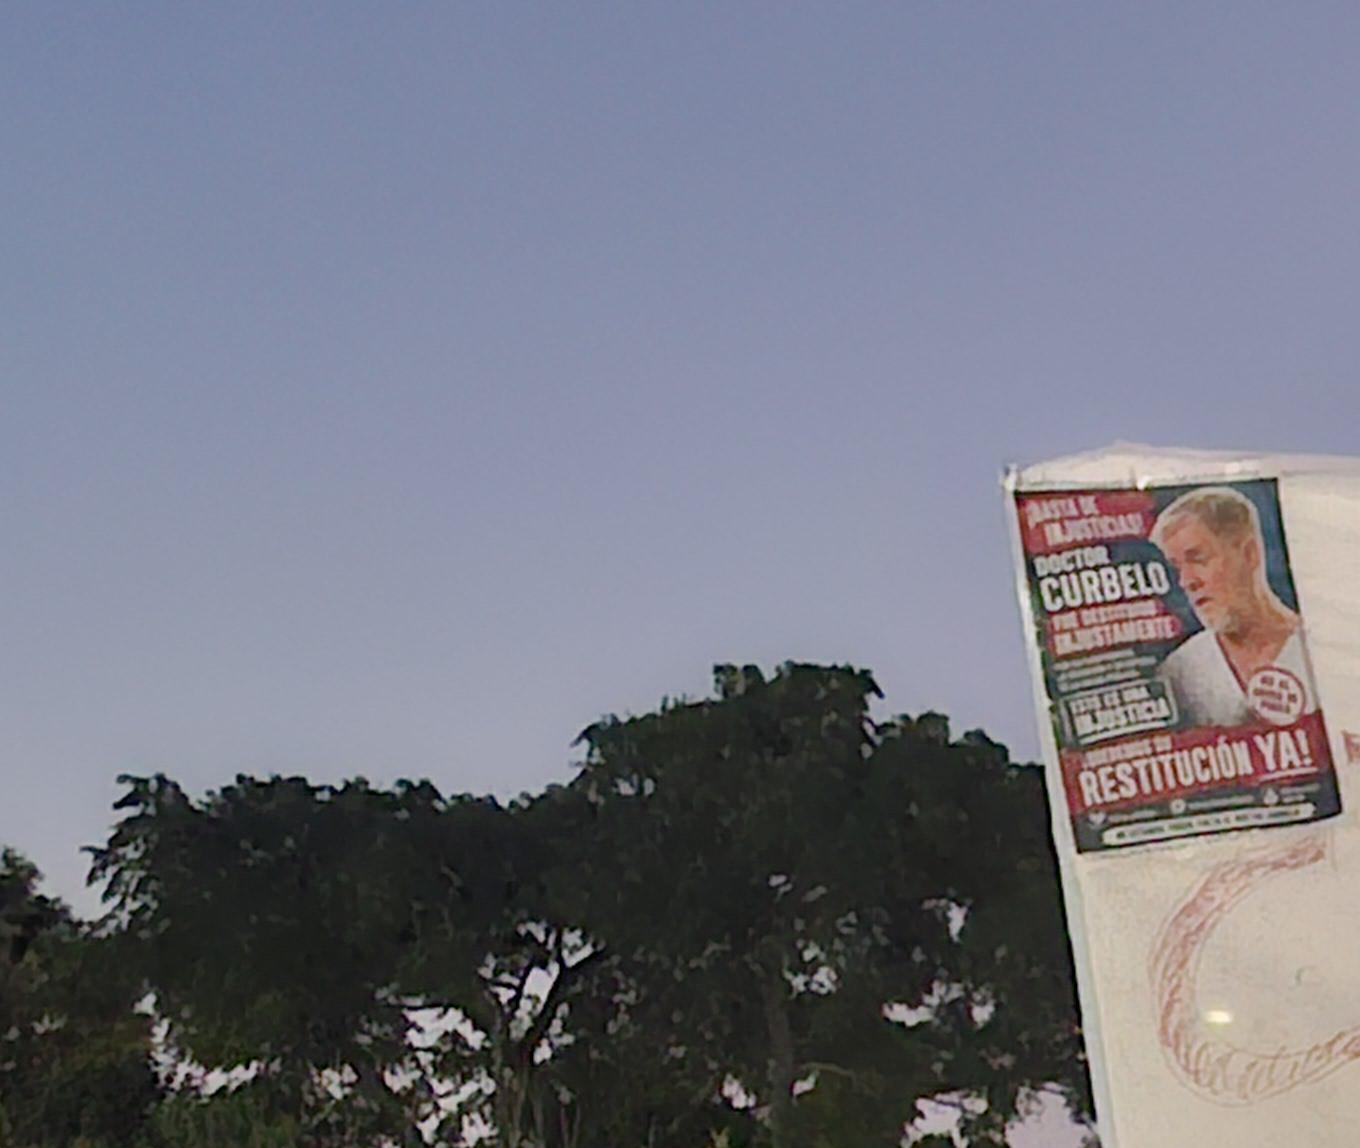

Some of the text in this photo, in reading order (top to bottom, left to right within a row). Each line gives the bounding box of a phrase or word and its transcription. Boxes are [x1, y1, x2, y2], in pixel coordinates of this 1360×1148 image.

[1033, 545, 1111, 578] DOCTOR
[1040, 561, 1170, 612] CURBELO
[1079, 736, 1253, 807] RESTITUCIÓN
[1254, 729, 1313, 771] YA!
